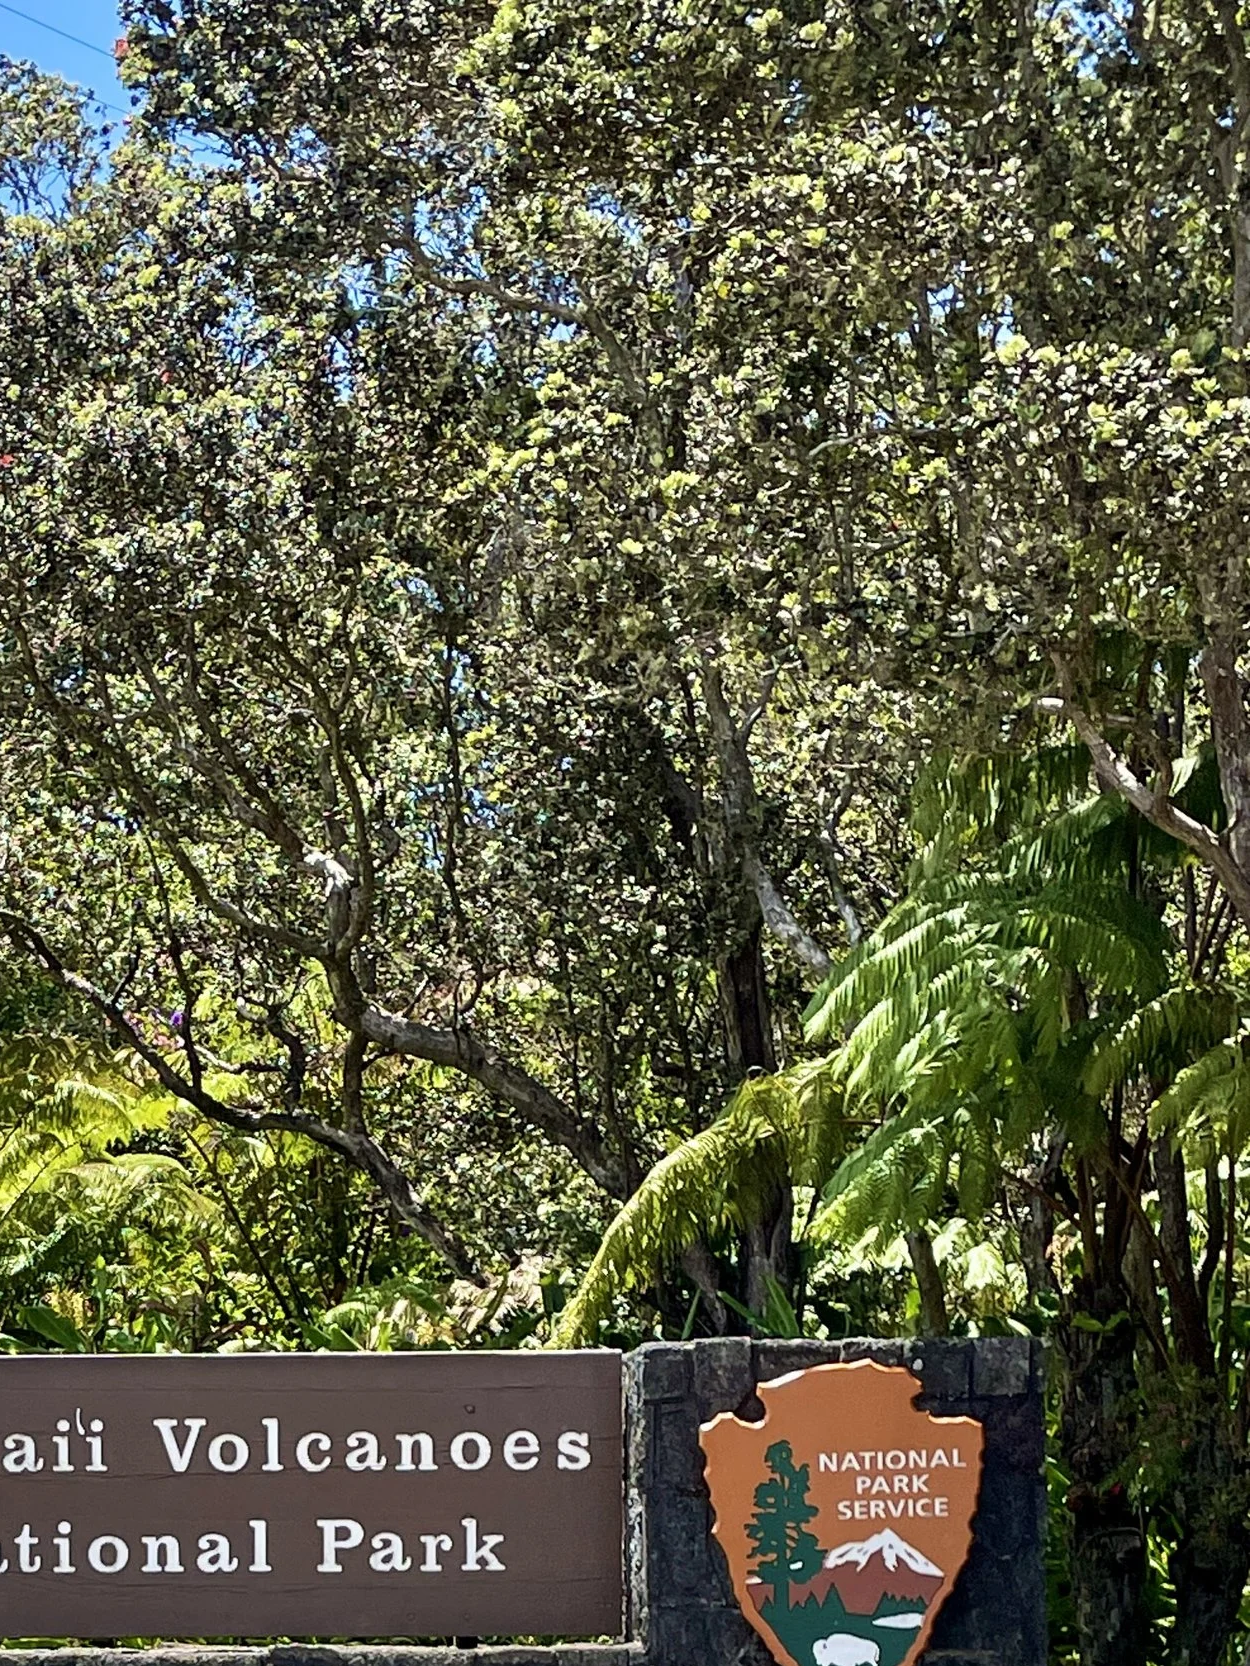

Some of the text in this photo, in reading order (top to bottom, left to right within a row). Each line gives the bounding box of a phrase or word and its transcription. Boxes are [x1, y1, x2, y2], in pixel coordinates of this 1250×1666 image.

[152, 1417, 591, 1473] Volcanoes
[817, 1447, 967, 1473] NATIONAL
[855, 1473, 930, 1496] PARK
[837, 1496, 950, 1521] SERVICE
[316, 1517, 506, 1573] Park
